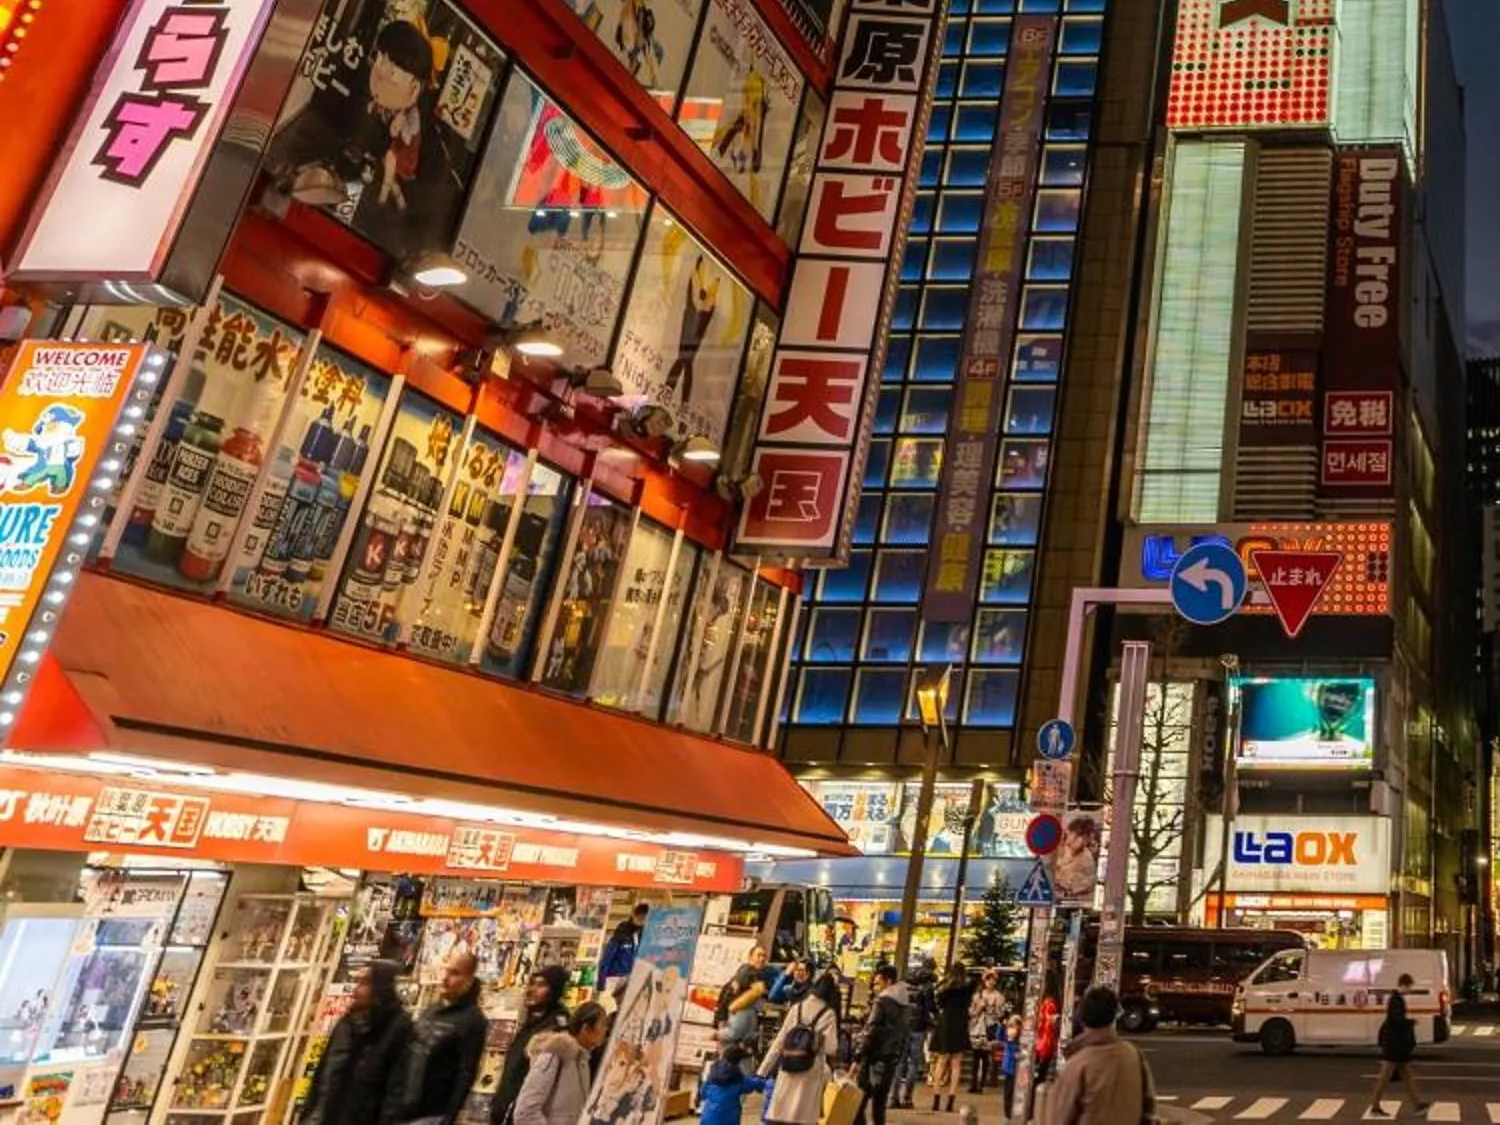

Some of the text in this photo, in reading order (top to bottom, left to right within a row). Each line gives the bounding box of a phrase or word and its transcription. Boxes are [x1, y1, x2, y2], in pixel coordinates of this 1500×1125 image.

[1353, 158, 1397, 329] Duty Free
[35, 351, 127, 366] WELCOME
[1331, 399, 1387, 426] 免税
[1270, 567, 1324, 587] 止まれ
